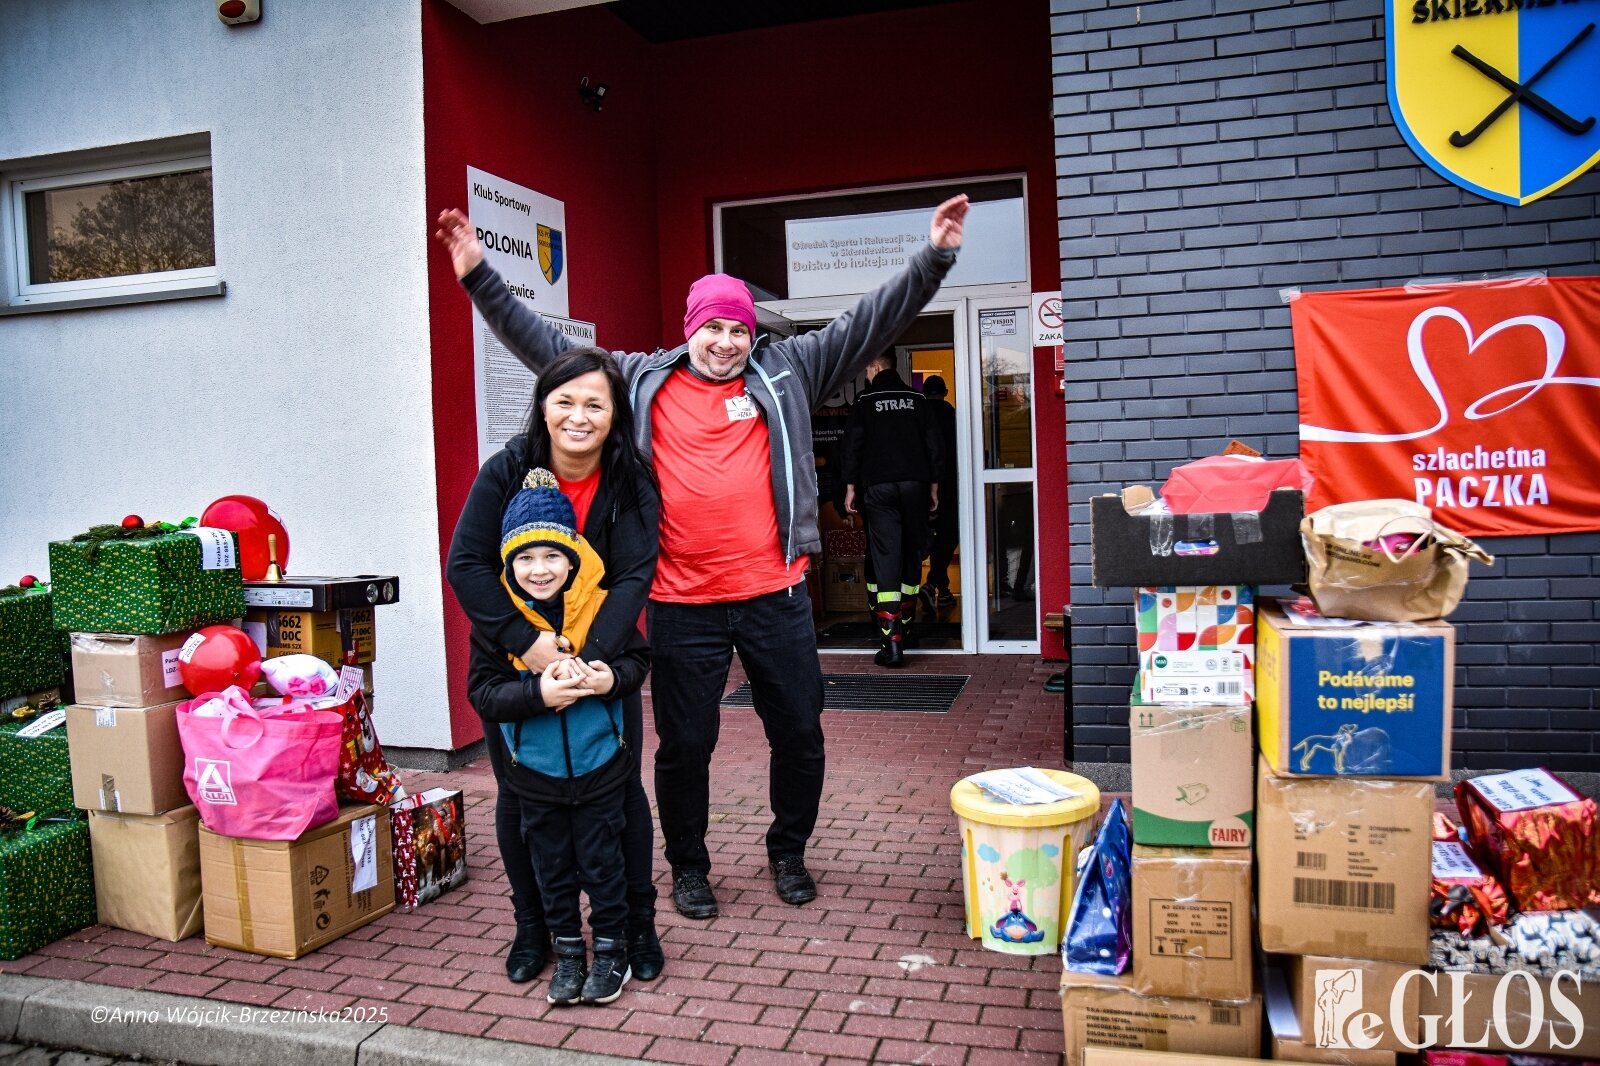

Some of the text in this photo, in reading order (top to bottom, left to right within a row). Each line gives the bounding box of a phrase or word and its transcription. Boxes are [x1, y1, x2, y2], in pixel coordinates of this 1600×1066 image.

[473, 182, 531, 216] Klub Sportowy
[476, 227, 533, 260] POLONIA
[792, 256, 905, 272] Boisko do hokeja na
[503, 281, 535, 300] iewice
[564, 324, 593, 340] SENIORA
[1039, 333, 1063, 341] ZAKA
[1412, 444, 1547, 472] szlachetna
[1413, 473, 1550, 508] PACZKA
[281, 630, 302, 642] 00C
[1318, 670, 1416, 688] Podáváme
[1317, 693, 1416, 714] to nejlepší
[204, 792, 230, 801] ALDI
[1211, 828, 1248, 843] FAIRY
